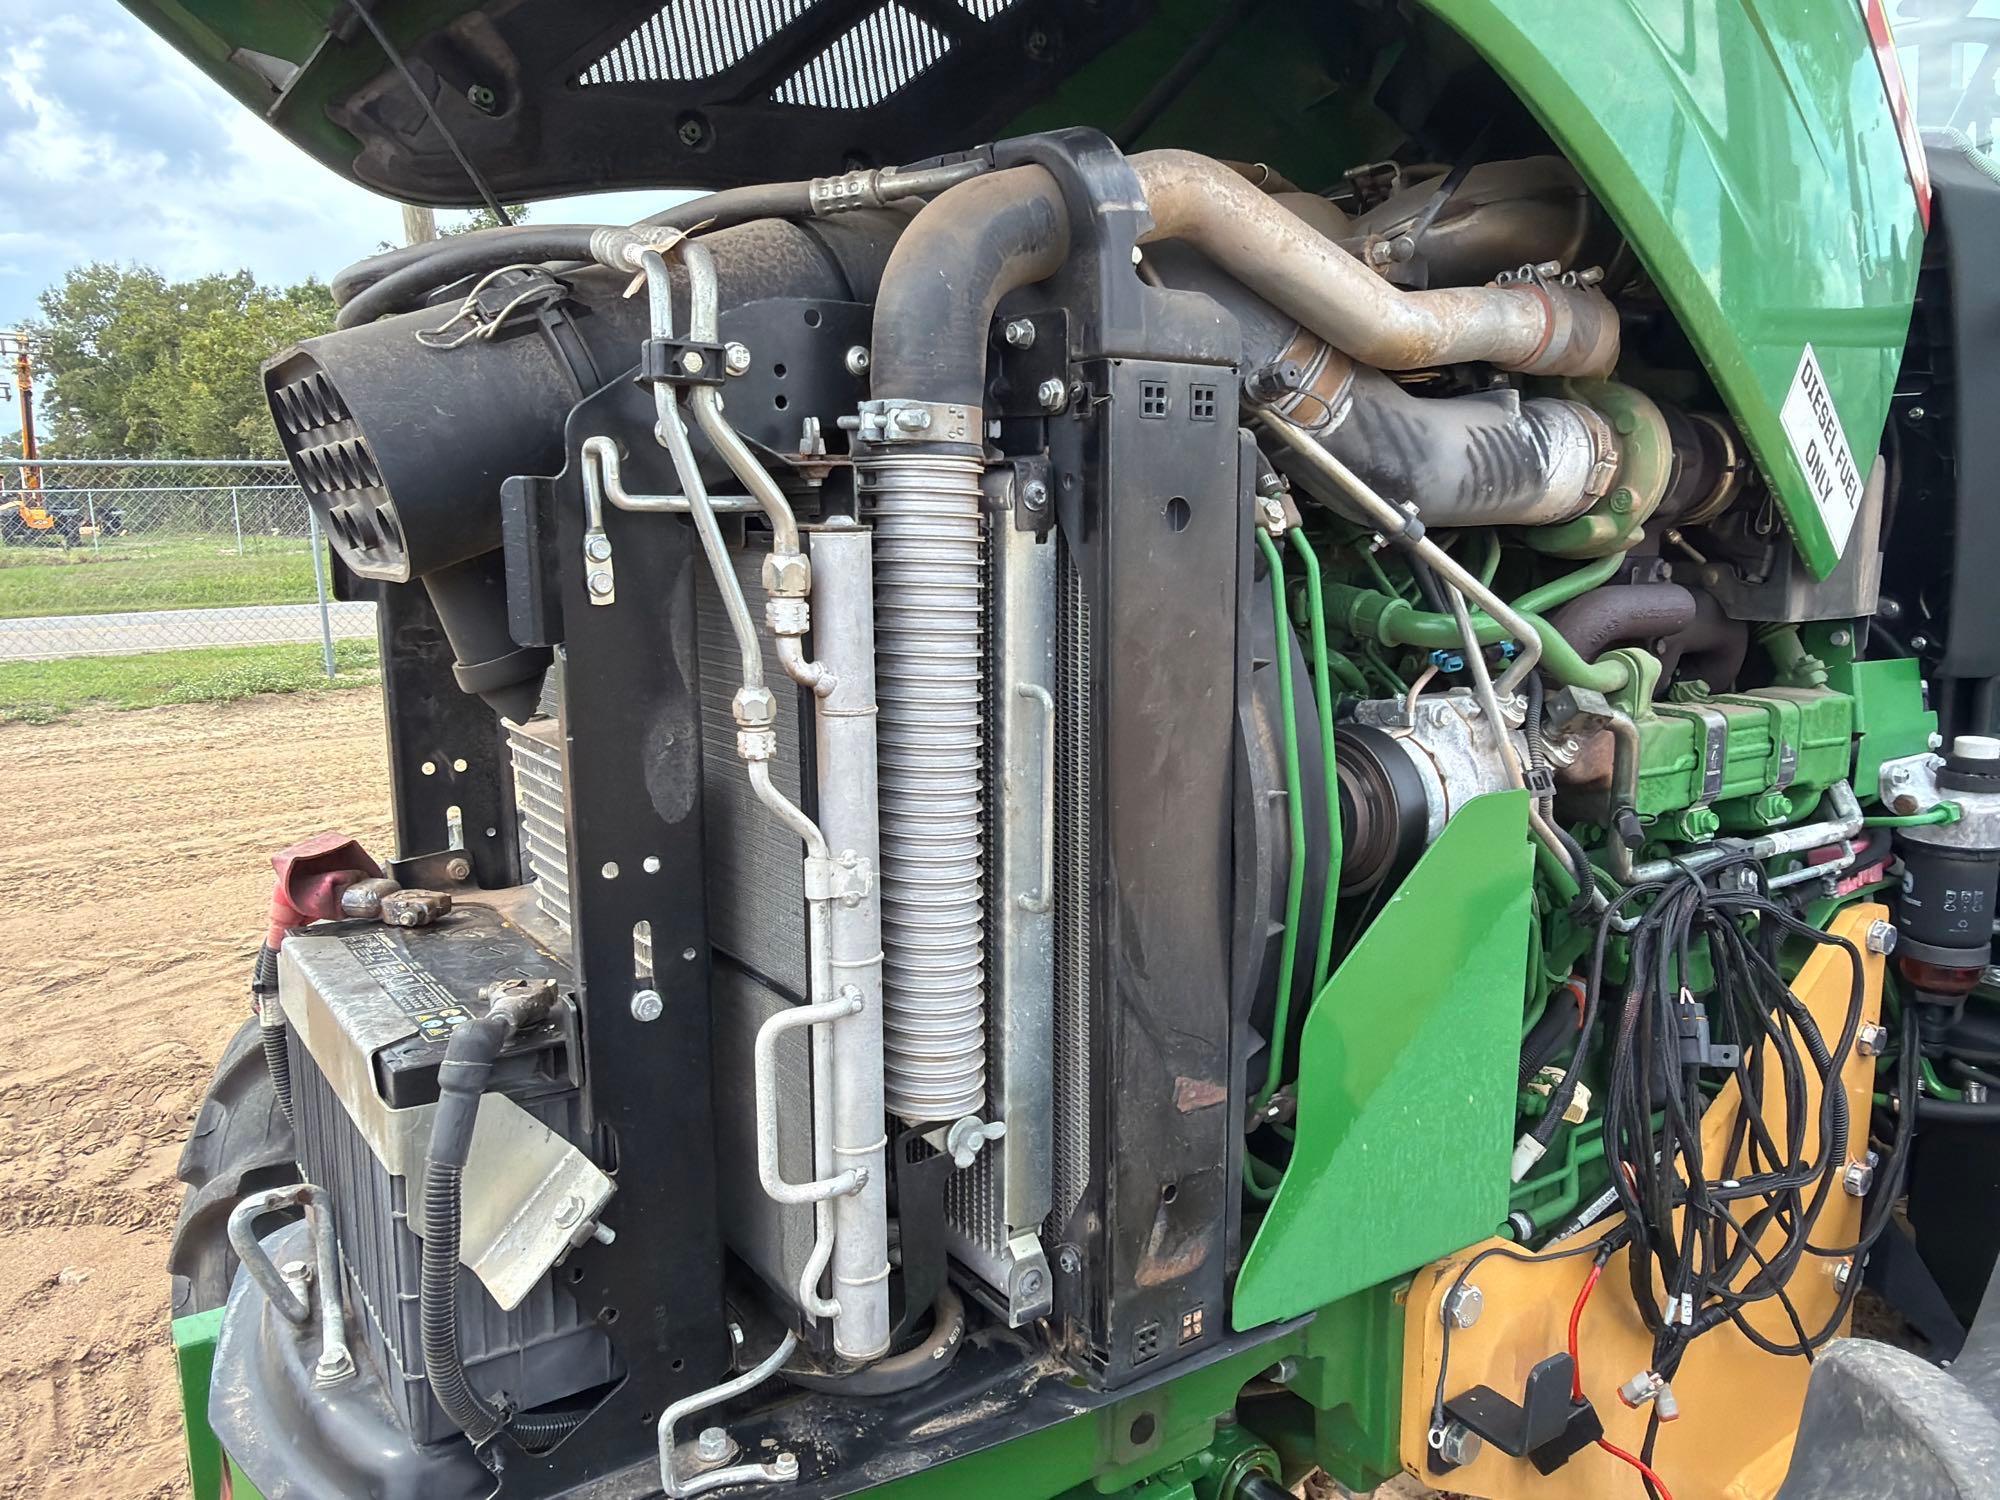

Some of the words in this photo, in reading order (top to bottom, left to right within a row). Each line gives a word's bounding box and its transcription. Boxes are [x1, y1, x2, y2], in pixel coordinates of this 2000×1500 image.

[1800, 356, 1838, 454] DIESEL
[1834, 445, 1858, 510] FUEL
[1805, 438, 1834, 504] ONLY
